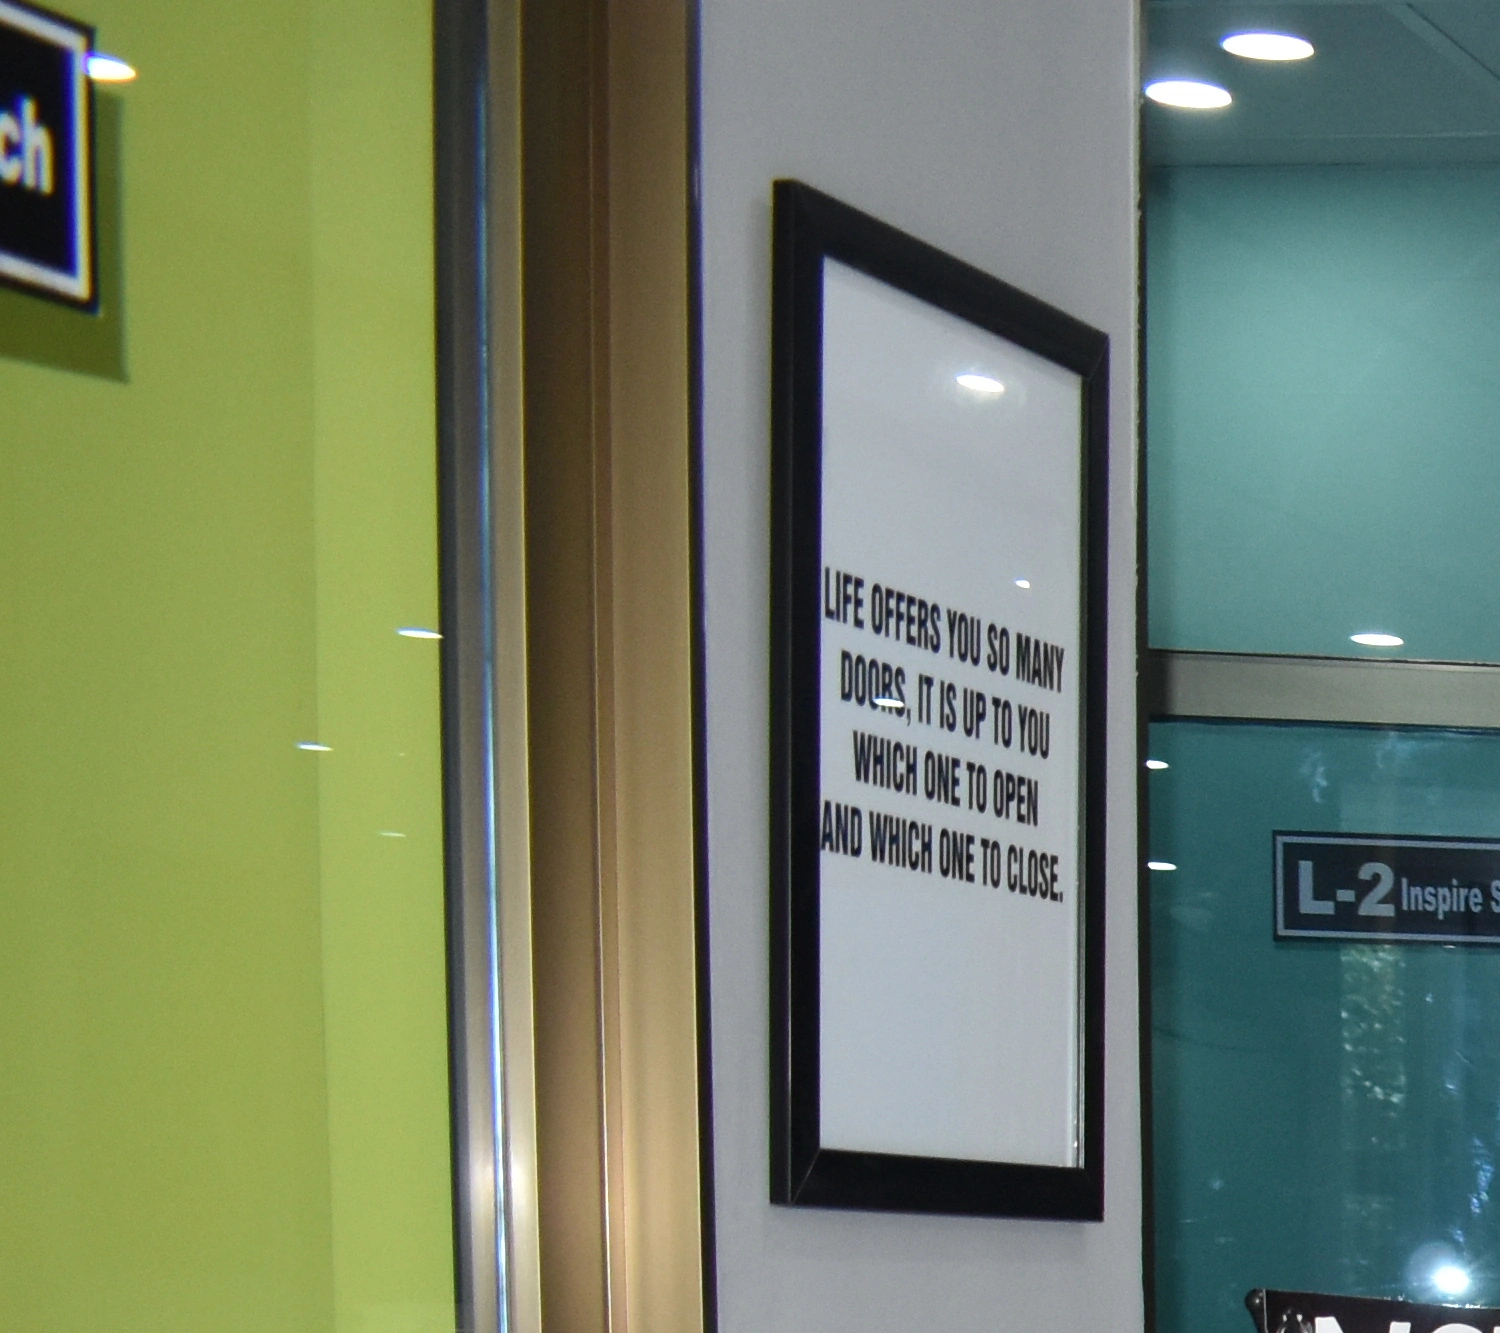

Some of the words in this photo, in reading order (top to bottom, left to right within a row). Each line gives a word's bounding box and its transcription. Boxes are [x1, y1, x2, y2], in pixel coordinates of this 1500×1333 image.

[825, 567, 864, 629] LIFE
[872, 584, 940, 653] OFFERS
[947, 609, 980, 666] YOU
[987, 624, 1009, 675] SO
[1016, 633, 1064, 692] MANY
[918, 674, 933, 725] IT
[940, 681, 956, 732] IS
[963, 688, 986, 739] UP
[992, 697, 1012, 748] TO
[1018, 704, 1049, 759] YOU
[853, 731, 917, 795] WHICH
[925, 751, 960, 806] ONE
[967, 762, 987, 813] TO
[994, 770, 1038, 826] OPEN
[820, 800, 862, 857] AND
[869, 811, 932, 873] WHICH
[940, 828, 975, 883] ONE
[981, 838, 1001, 888] TO
[1008, 845, 1063, 902] CLOSE.
[1299, 861, 1395, 917] L-2
[1402, 878, 1482, 920] Inspire
